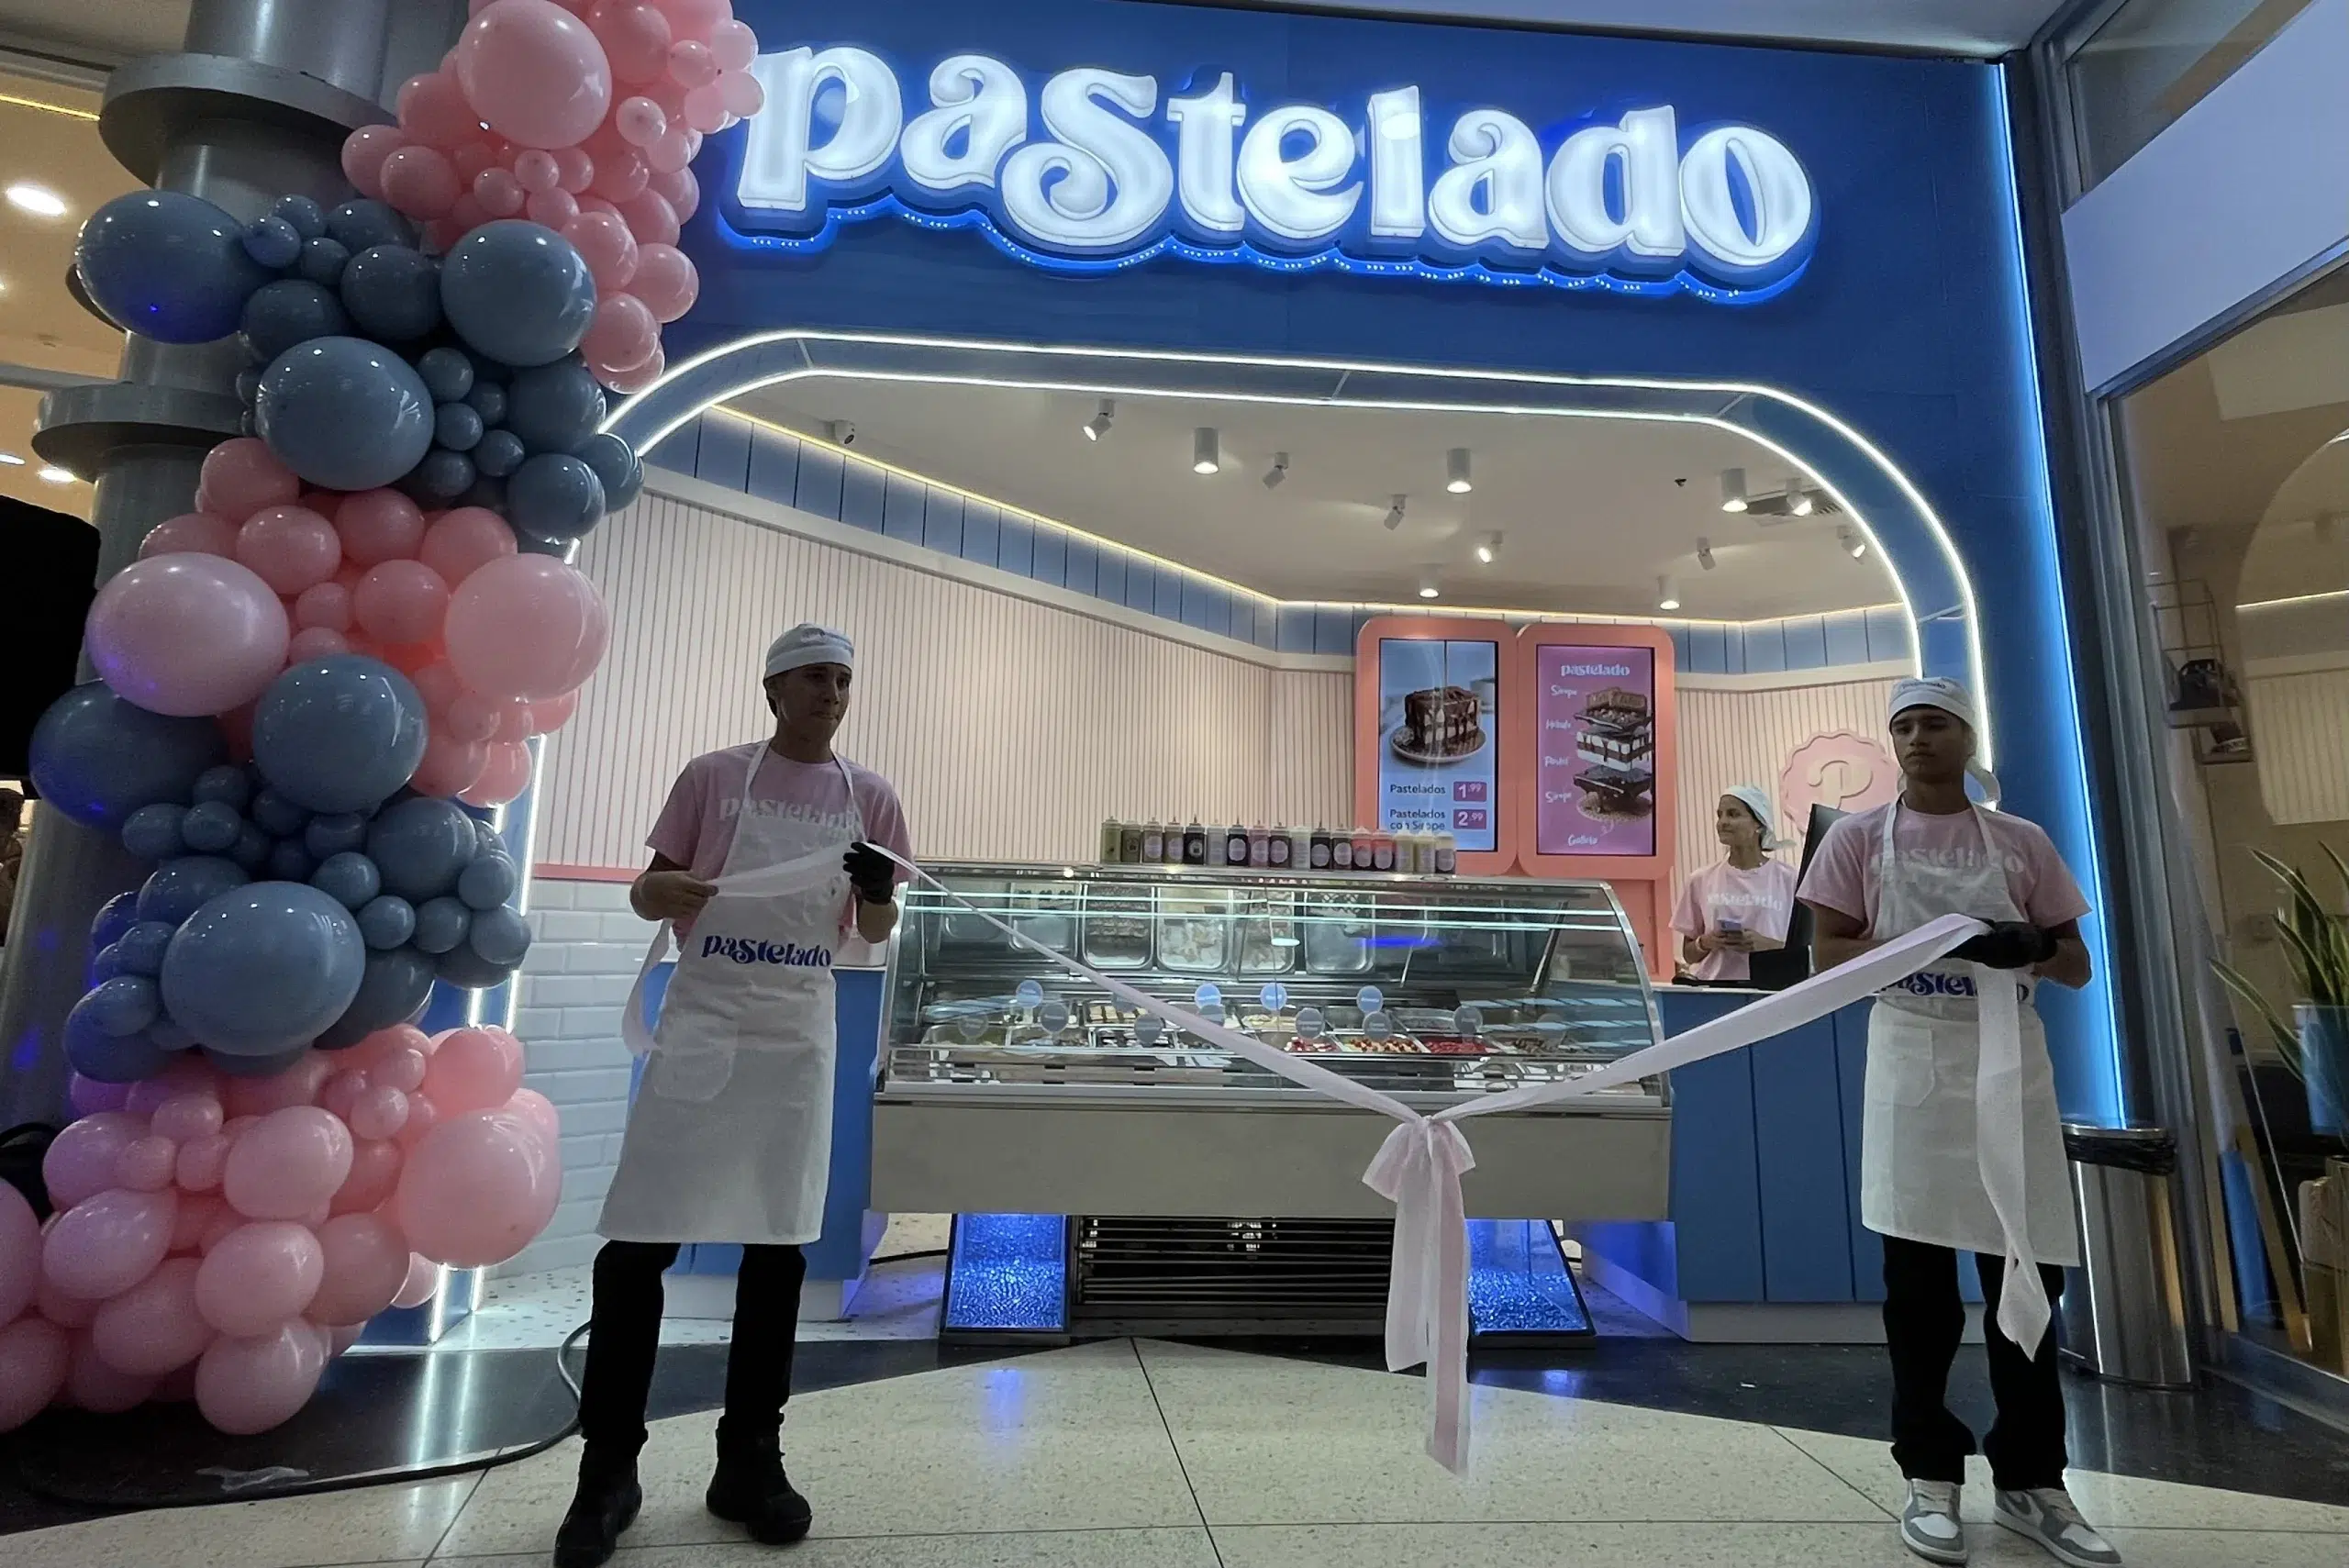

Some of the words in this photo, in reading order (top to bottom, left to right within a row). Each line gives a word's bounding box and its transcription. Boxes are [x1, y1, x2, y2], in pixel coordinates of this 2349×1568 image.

[737, 45, 1815, 267] pastelado
[1390, 784, 1446, 795] Pastelados
[1390, 808, 1446, 819] Pastelados
[701, 935, 831, 967] pastelado
